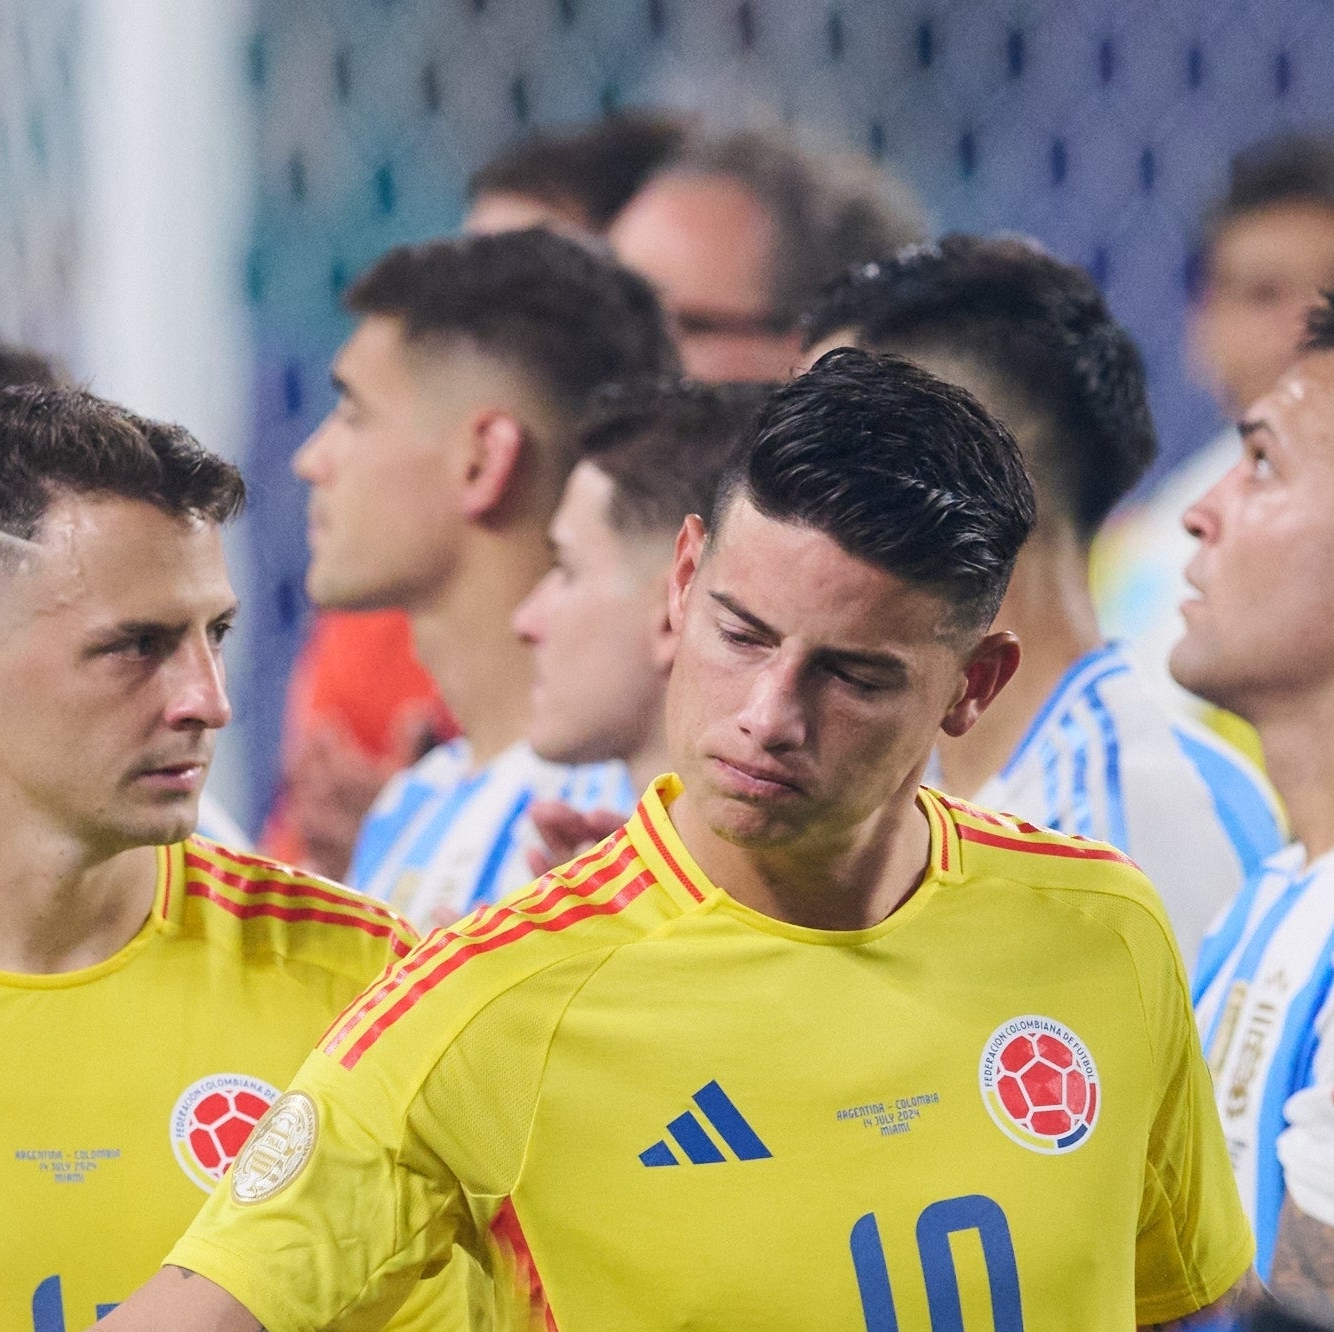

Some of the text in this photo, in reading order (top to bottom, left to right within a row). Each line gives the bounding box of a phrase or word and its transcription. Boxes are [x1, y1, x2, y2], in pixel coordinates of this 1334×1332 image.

[1005, 1020, 1062, 1037] COLOMBIANA
[1062, 1032, 1075, 1045] DE
[836, 1103, 885, 1121] ARGENTINA
[895, 1092, 940, 1110] COLOMBIA
[863, 1109, 921, 1128] 14 JULY 2024
[880, 1122, 911, 1137] MIAMI
